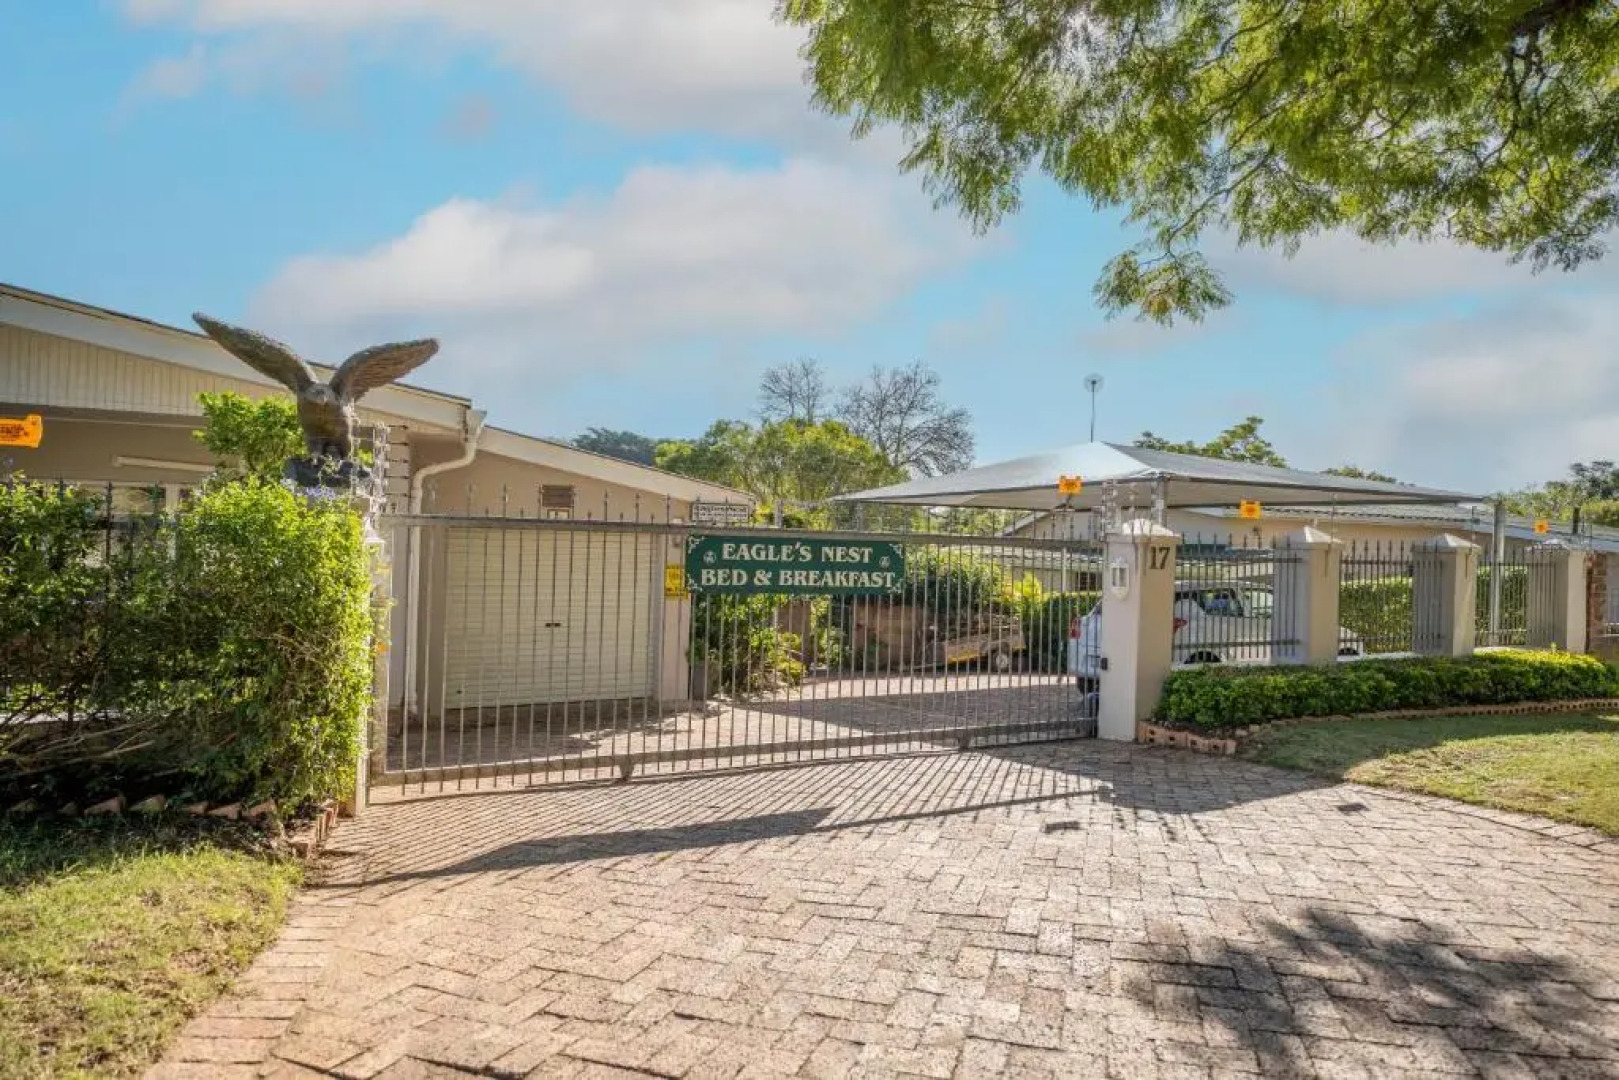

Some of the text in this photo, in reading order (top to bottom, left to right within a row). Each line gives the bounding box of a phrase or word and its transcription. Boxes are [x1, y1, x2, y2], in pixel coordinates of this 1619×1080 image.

[722, 542, 873, 564] EAGLE'S NEST
[1150, 546, 1170, 570] 17
[701, 569, 748, 586] BED
[753, 569, 772, 586] &
[778, 570, 895, 588] BREAKFAST
